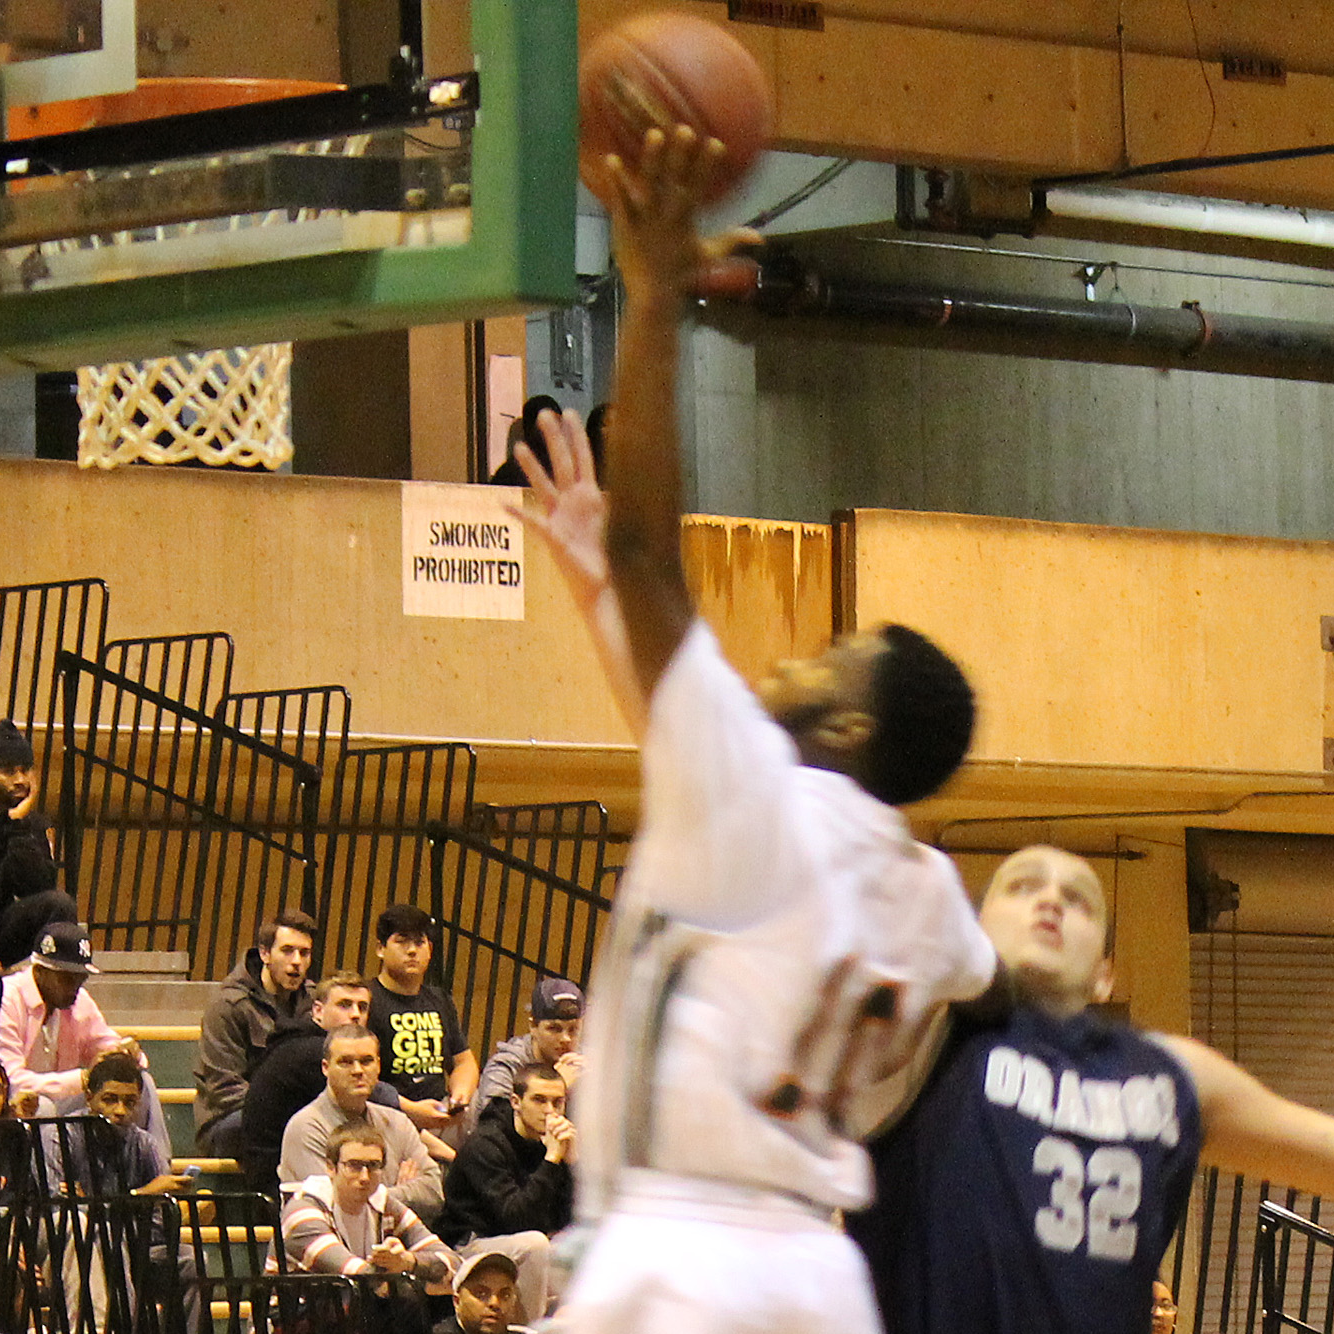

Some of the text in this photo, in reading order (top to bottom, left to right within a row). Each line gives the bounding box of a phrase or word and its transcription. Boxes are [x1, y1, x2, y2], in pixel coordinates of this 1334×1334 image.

[429, 521, 509, 549] SMOKING
[413, 556, 521, 587] PROHIBITED
[390, 1011, 443, 1032] COME
[392, 1030, 444, 1059] GET
[391, 1055, 444, 1074] SOME
[1033, 1135, 1142, 1263] 32
